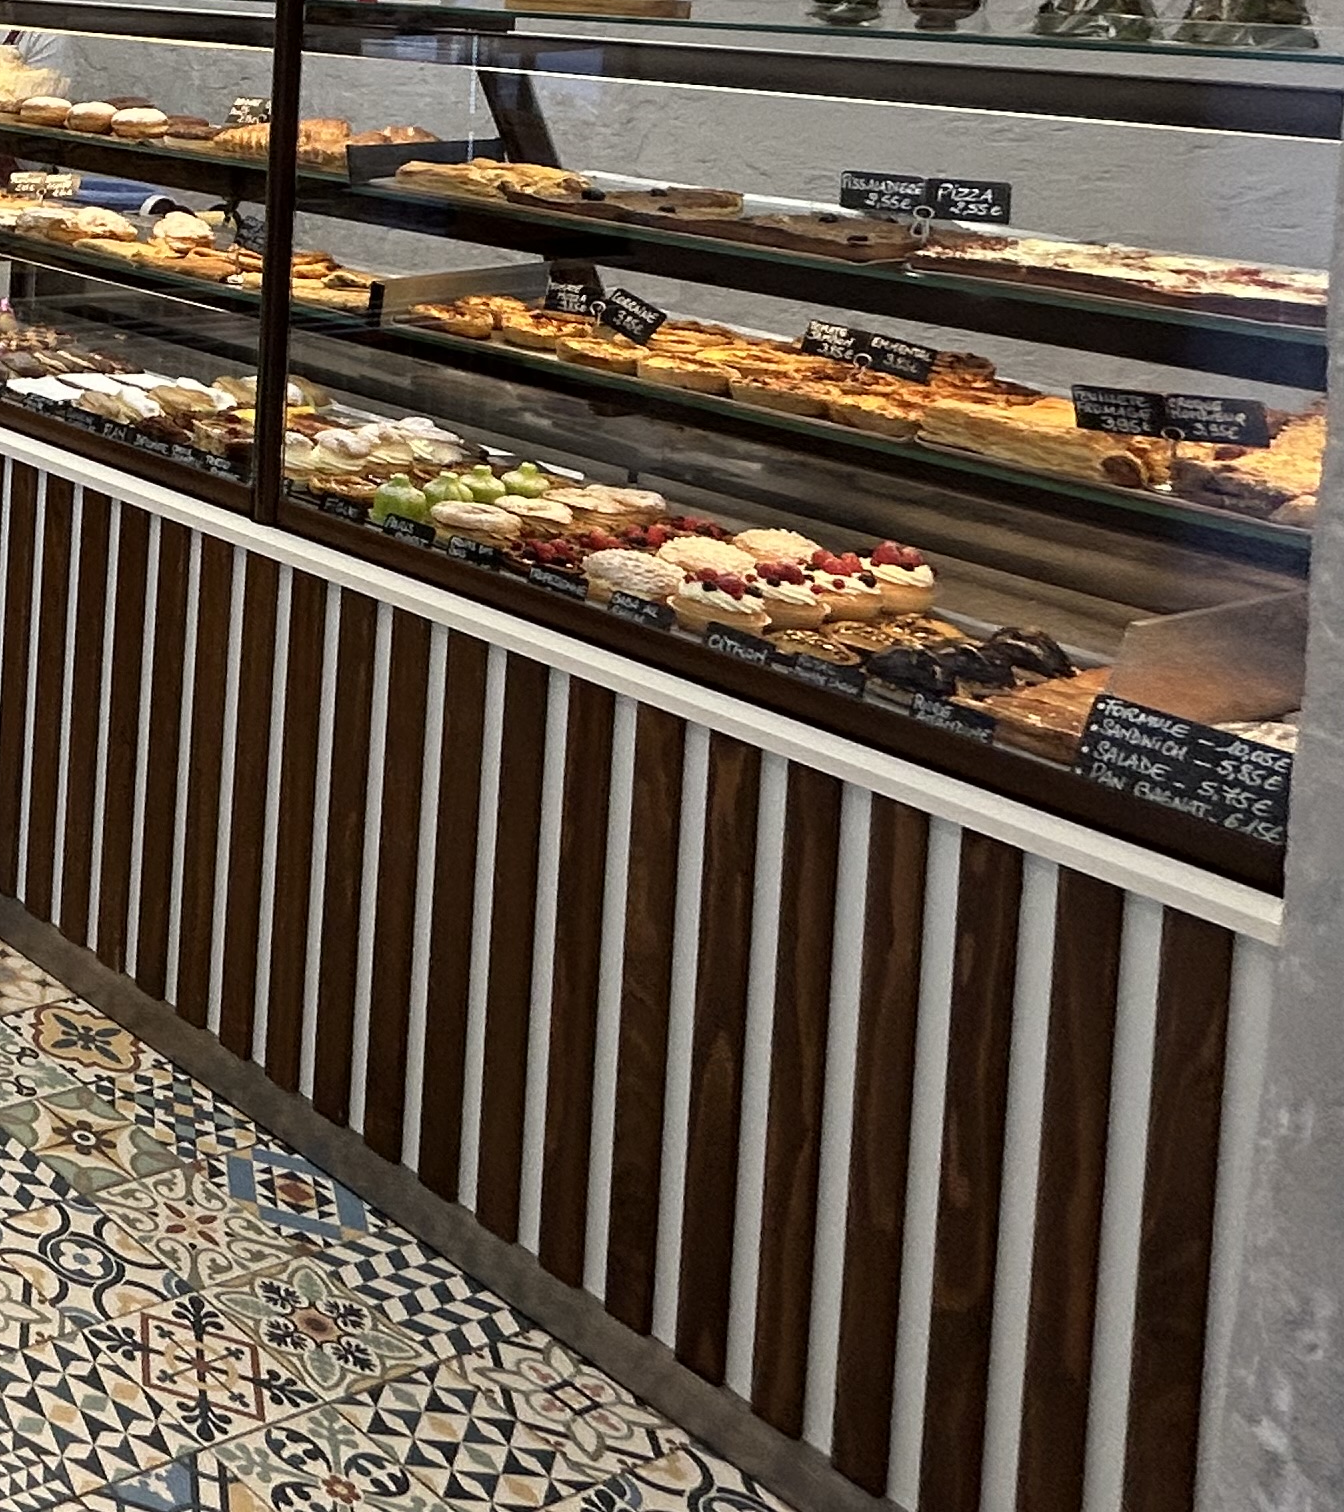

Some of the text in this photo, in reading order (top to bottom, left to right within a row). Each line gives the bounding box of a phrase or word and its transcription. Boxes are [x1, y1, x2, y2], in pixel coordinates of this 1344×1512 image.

[937, 182, 994, 204] PIZZA
[1104, 698, 1191, 738] FORMULE
[1089, 762, 1126, 791] PAN
[1092, 740, 1172, 782] SALADE
